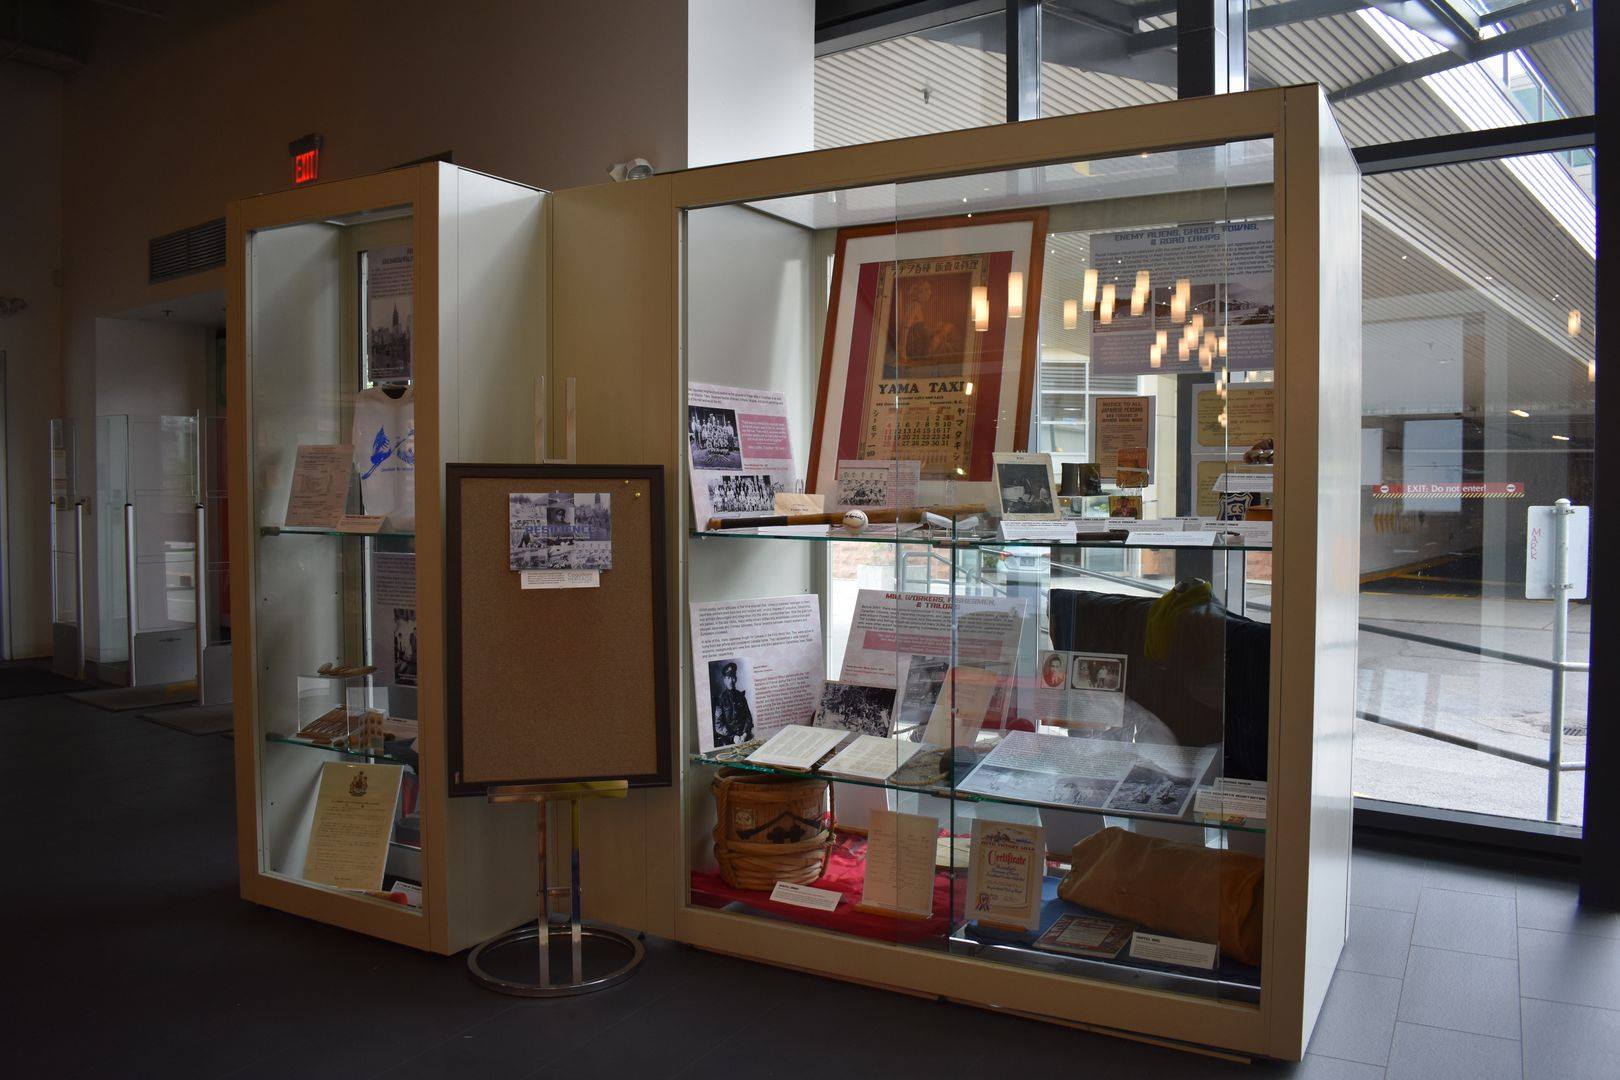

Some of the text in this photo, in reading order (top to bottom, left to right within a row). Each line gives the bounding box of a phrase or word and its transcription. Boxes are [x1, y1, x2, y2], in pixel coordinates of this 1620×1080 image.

[295, 150, 316, 183] EXIT
[1115, 232, 1144, 242] ENEMY
[1183, 226, 1216, 236] GHOST
[1160, 236, 1185, 245] ROAD
[1187, 233, 1221, 243] CAMPS
[878, 381, 965, 395] YAMA TAXI
[1407, 485, 1429, 493] EXIT:
[1431, 485, 1444, 493] Do
[1462, 484, 1487, 492] enter!
[1530, 527, 1542, 560] MARK
[905, 594, 945, 603] WORKERS,
[947, 596, 996, 606] FSHERMEN,
[988, 849, 1027, 866] Certificate
